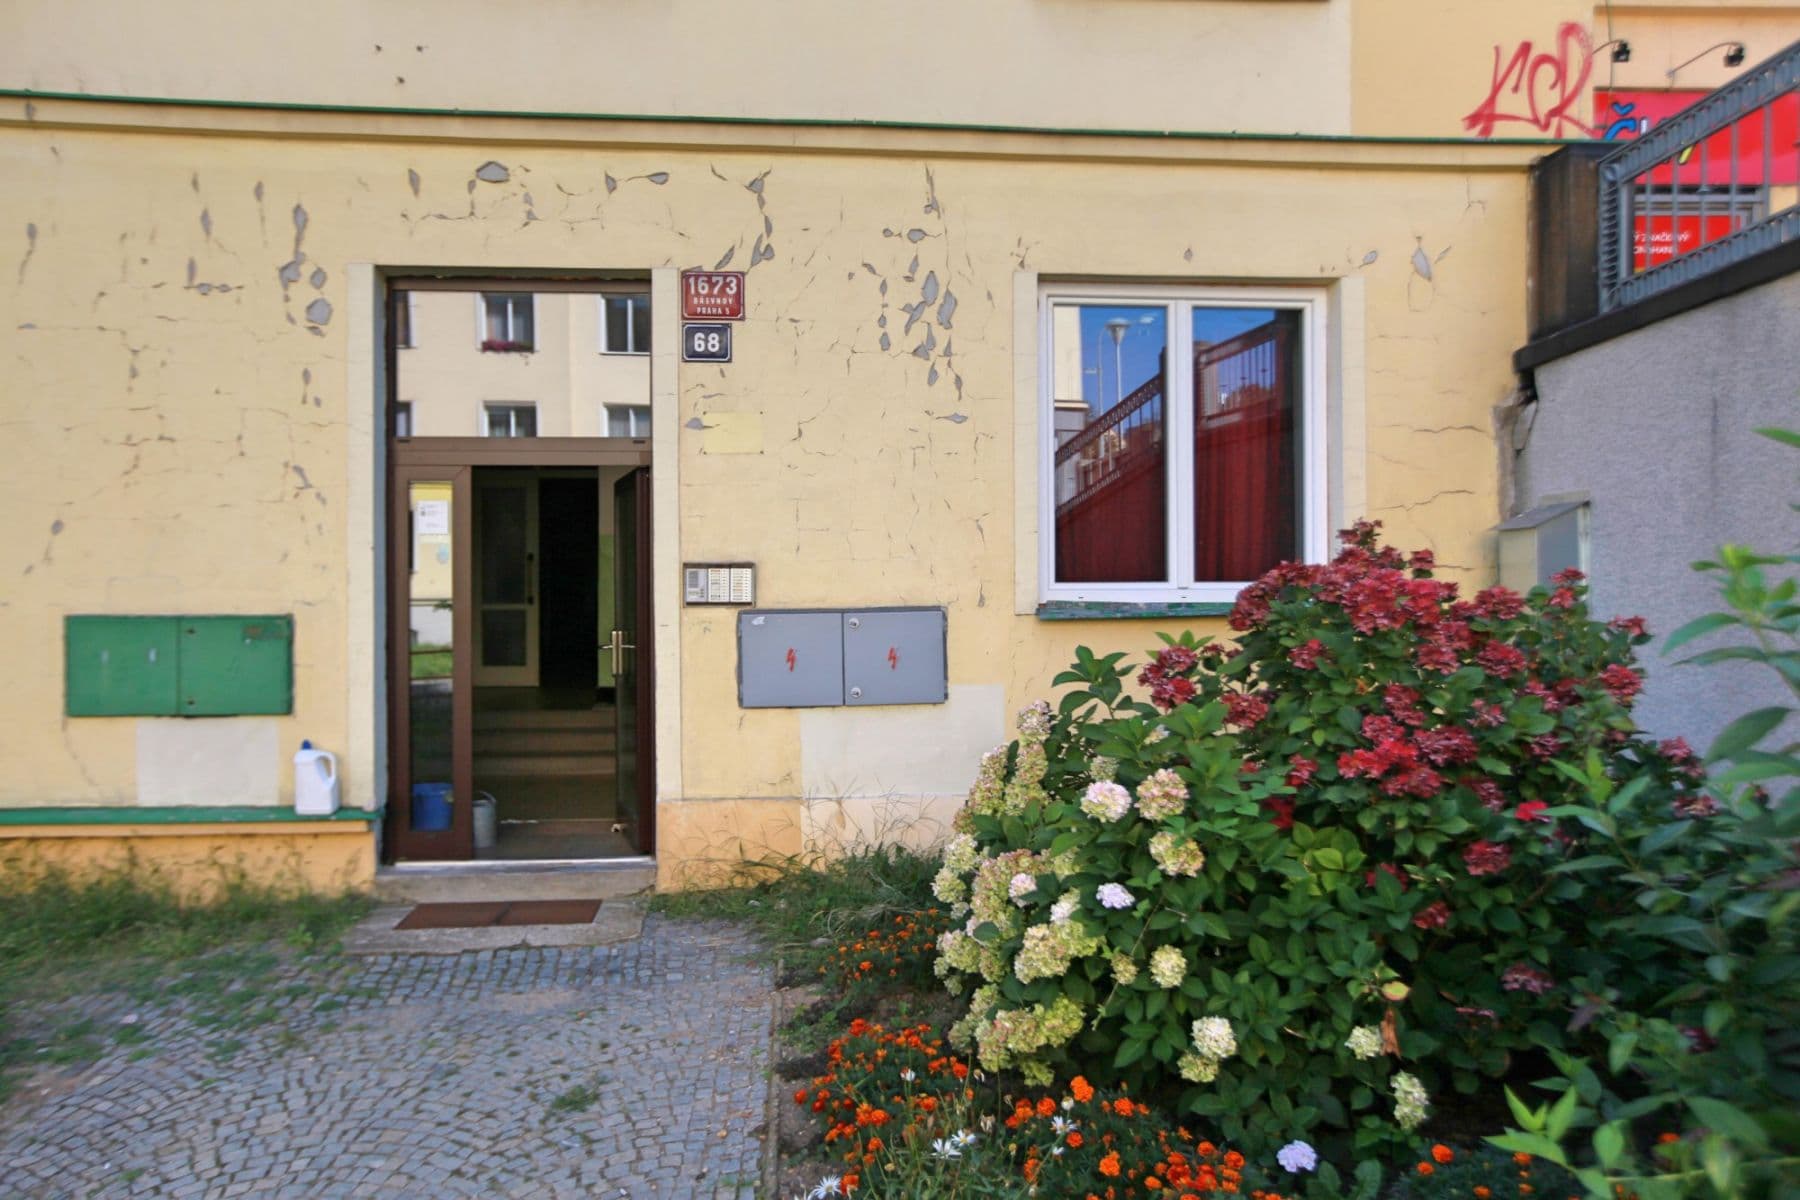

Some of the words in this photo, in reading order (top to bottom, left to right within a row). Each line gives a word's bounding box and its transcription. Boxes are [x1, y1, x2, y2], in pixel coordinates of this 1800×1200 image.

[689, 276, 737, 295] 1673
[696, 307, 722, 315] PRAHA
[694, 332, 720, 352] 68
